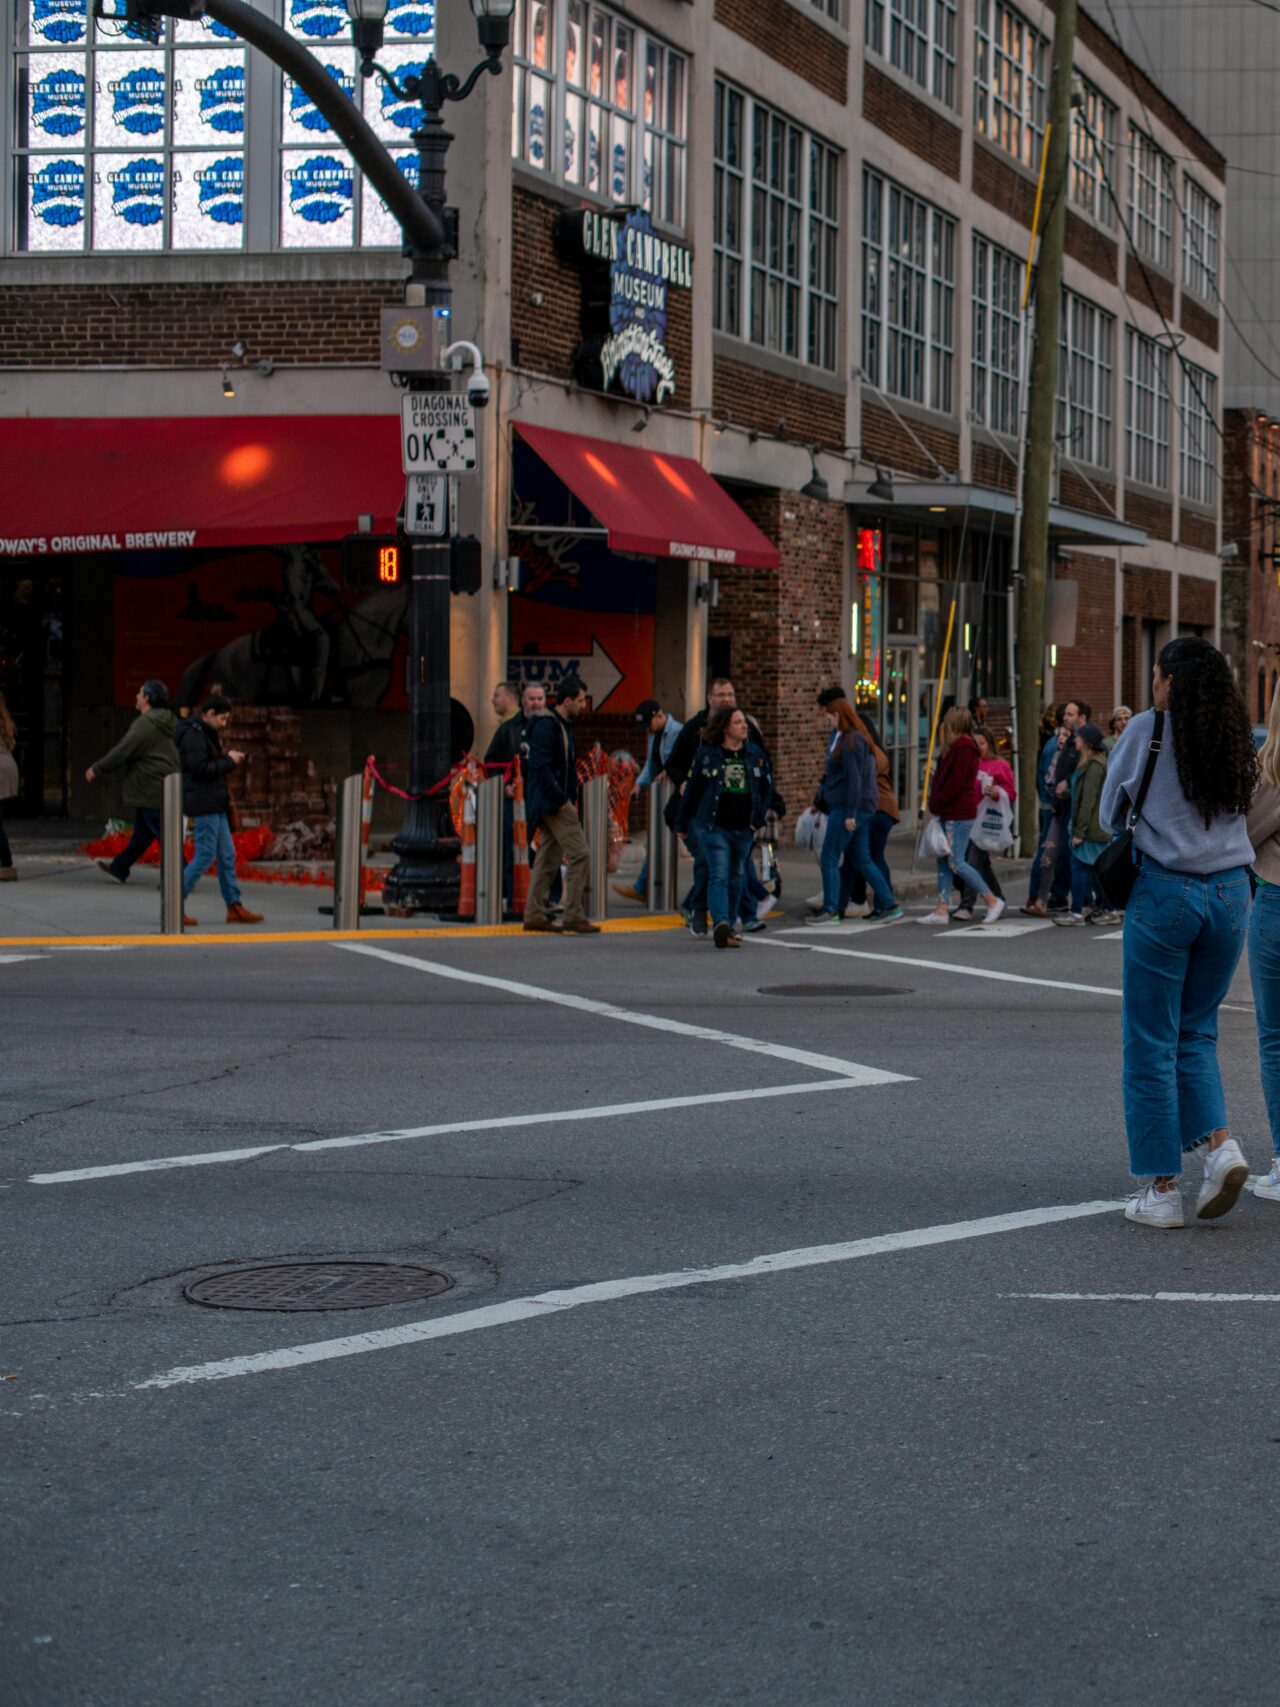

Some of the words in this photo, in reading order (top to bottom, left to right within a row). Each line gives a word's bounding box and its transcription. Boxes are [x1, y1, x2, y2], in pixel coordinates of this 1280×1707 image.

[28, 82, 50, 93] GLEN
[107, 80, 131, 92] GLEN
[194, 79, 217, 91] GLEN
[47, 92, 81, 100] MUSEUM
[28, 173, 50, 183] GLEN
[107, 171, 131, 182] GLEN
[194, 170, 217, 181] GLEN
[285, 169, 309, 181] GLEN
[312, 168, 354, 179] CAMPBEL
[128, 182, 161, 190] MUSEUM
[305, 180, 340, 188] MUSEUM
[582, 209, 620, 261] GLEN
[626, 228, 693, 288] CAMPBELL
[613, 271, 665, 311] MUSEUM
[411, 396, 468, 411] DIAGONAL
[412, 412, 468, 427] CROSSING
[407, 433, 435, 462] OK
[51, 534, 121, 551] ORIGINAL
[125, 530, 197, 548] BREWERY
[380, 547, 397, 581] 18
[507, 659, 580, 681] EUM
